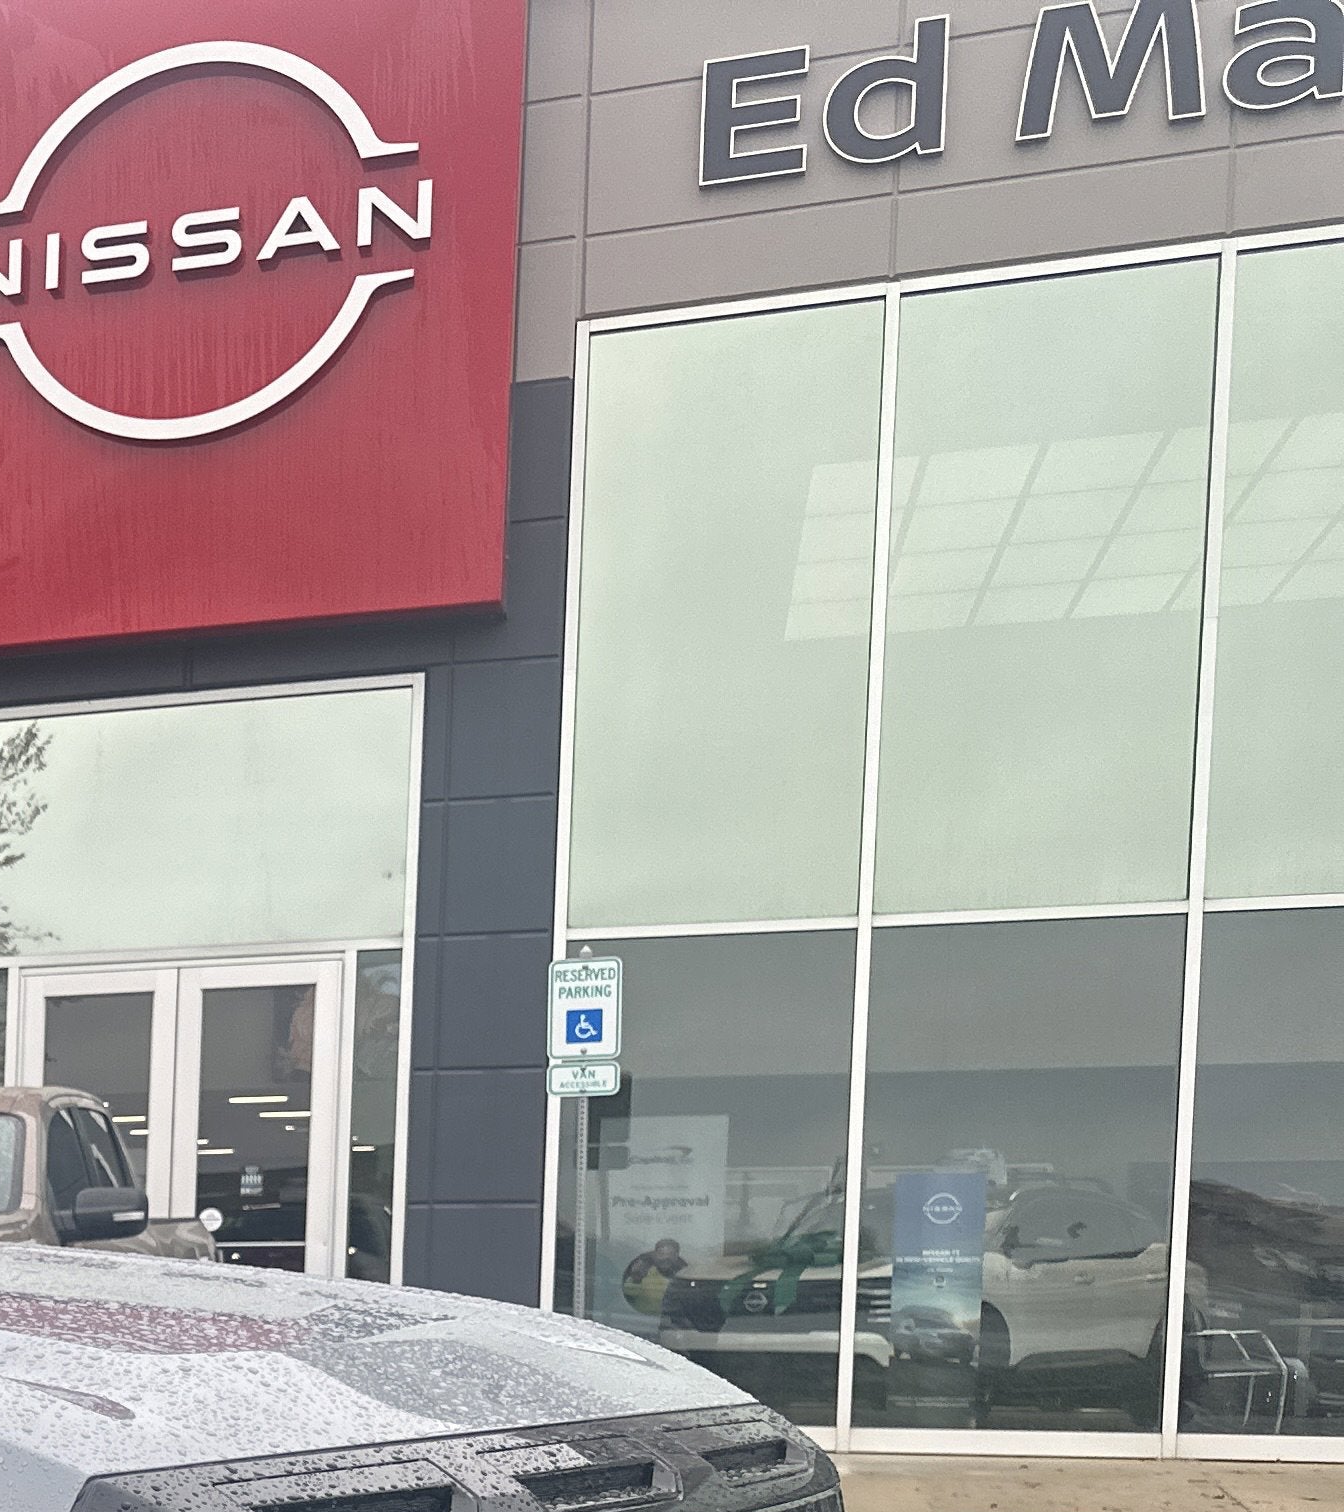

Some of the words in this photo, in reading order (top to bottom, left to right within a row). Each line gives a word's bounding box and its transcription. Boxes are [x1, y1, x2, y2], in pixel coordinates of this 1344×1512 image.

[699, 14, 950, 186] Ed
[554, 967, 616, 983] RESERVED
[558, 985, 612, 1000] PARKING
[571, 1070, 596, 1080] VAN
